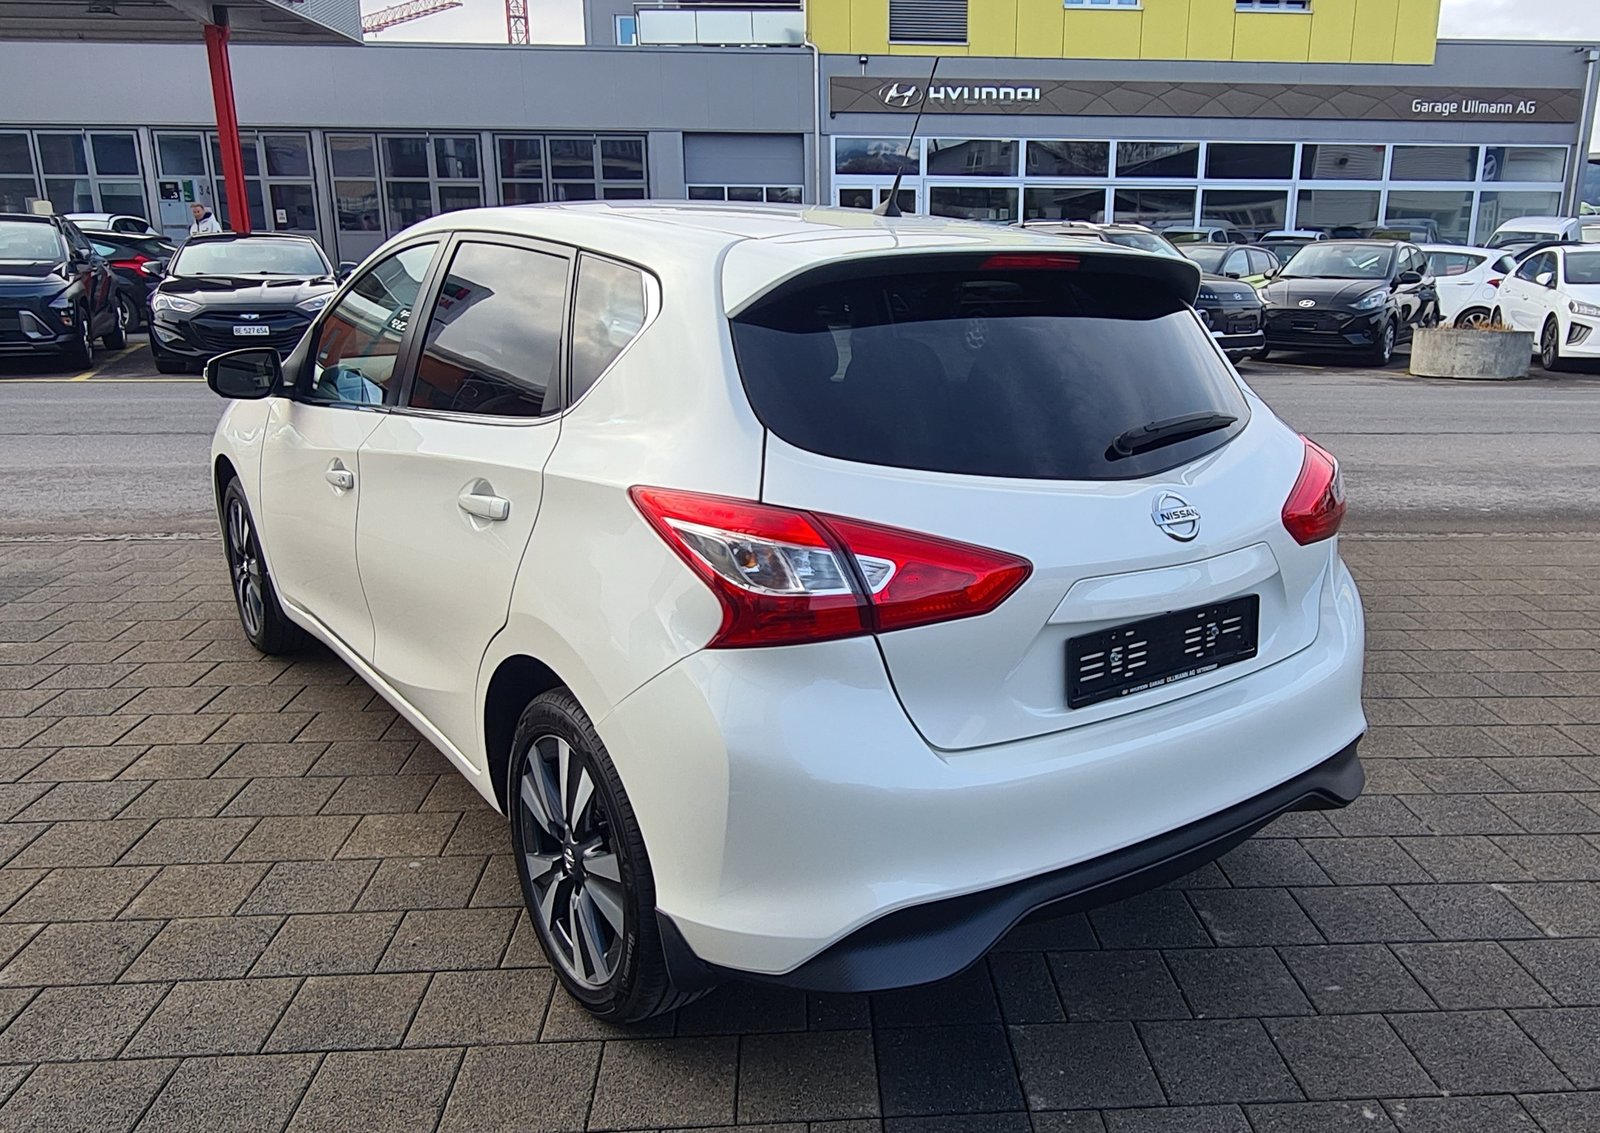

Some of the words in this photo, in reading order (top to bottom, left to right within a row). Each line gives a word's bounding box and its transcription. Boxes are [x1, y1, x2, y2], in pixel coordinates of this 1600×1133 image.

[929, 86, 1040, 104] HYUNDAI
[1412, 99, 1458, 116] Garage
[1461, 99, 1512, 114] Ullmann
[1516, 100, 1536, 114] AG
[1160, 509, 1199, 521] NISSAN
